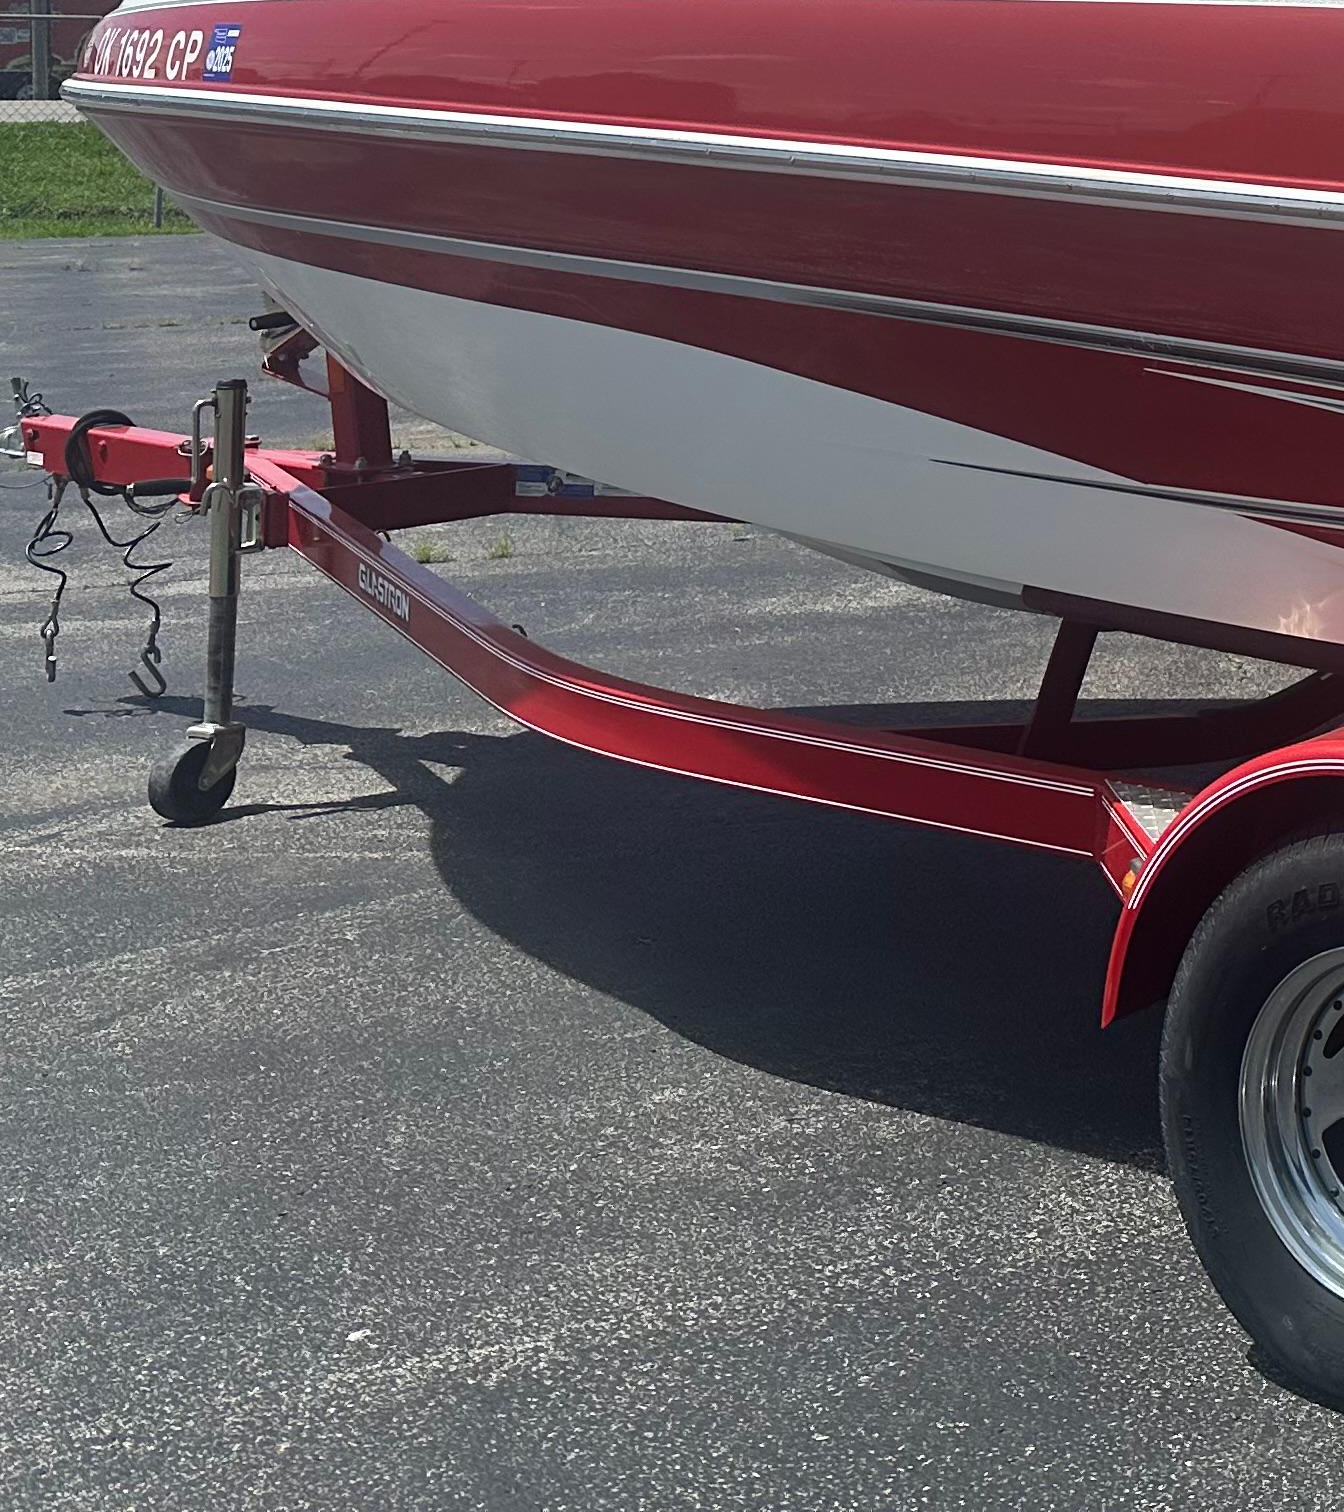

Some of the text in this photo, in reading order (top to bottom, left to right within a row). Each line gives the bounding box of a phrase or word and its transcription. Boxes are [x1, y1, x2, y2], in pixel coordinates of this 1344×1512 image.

[94, 28, 204, 81] OK 1692 CP
[212, 46, 235, 73] 2025
[359, 562, 409, 622] GLASTRON
